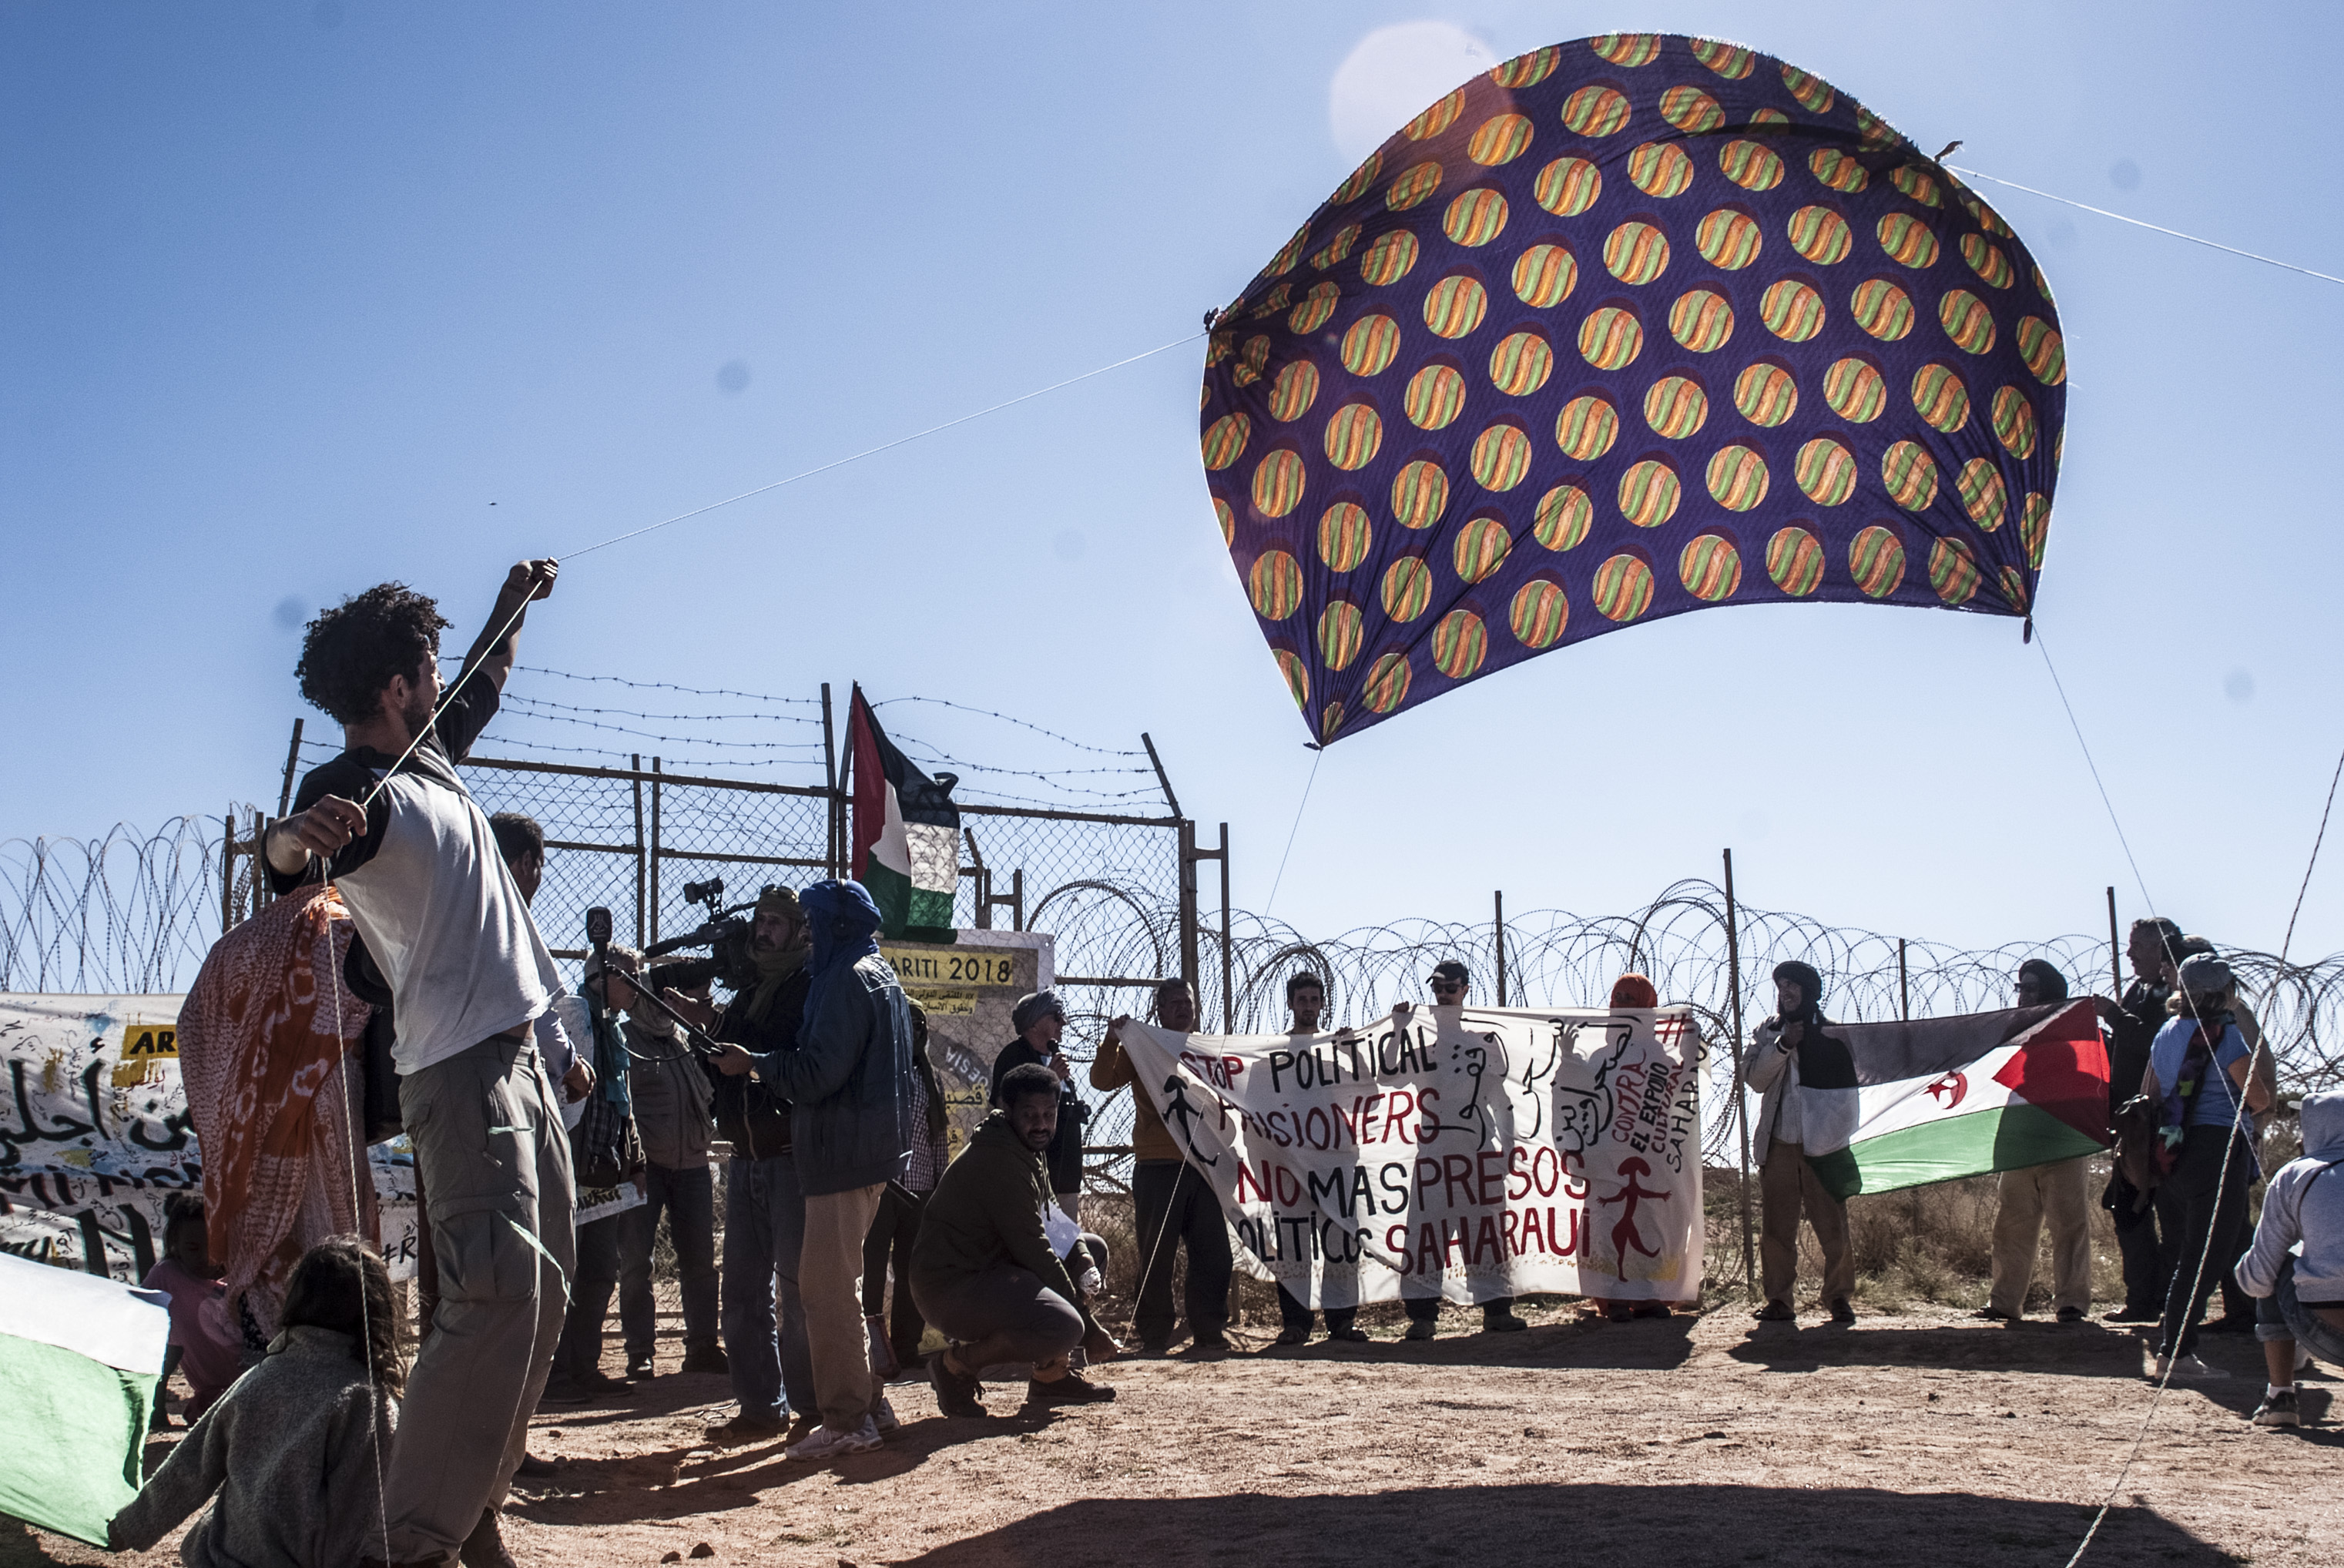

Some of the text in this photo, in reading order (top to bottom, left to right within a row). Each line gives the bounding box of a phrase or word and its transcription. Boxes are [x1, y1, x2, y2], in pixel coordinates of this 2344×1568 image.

[889, 957, 1011, 983] ARITI 2018
[1179, 1051, 1245, 1091] STOP
[1612, 1048, 1647, 1142] CONTRA
[1651, 1060, 1685, 1154] CULTURAL
[1630, 1131, 1650, 1154] EL
[1237, 1146, 1591, 1218] NO MAS PRESOS
